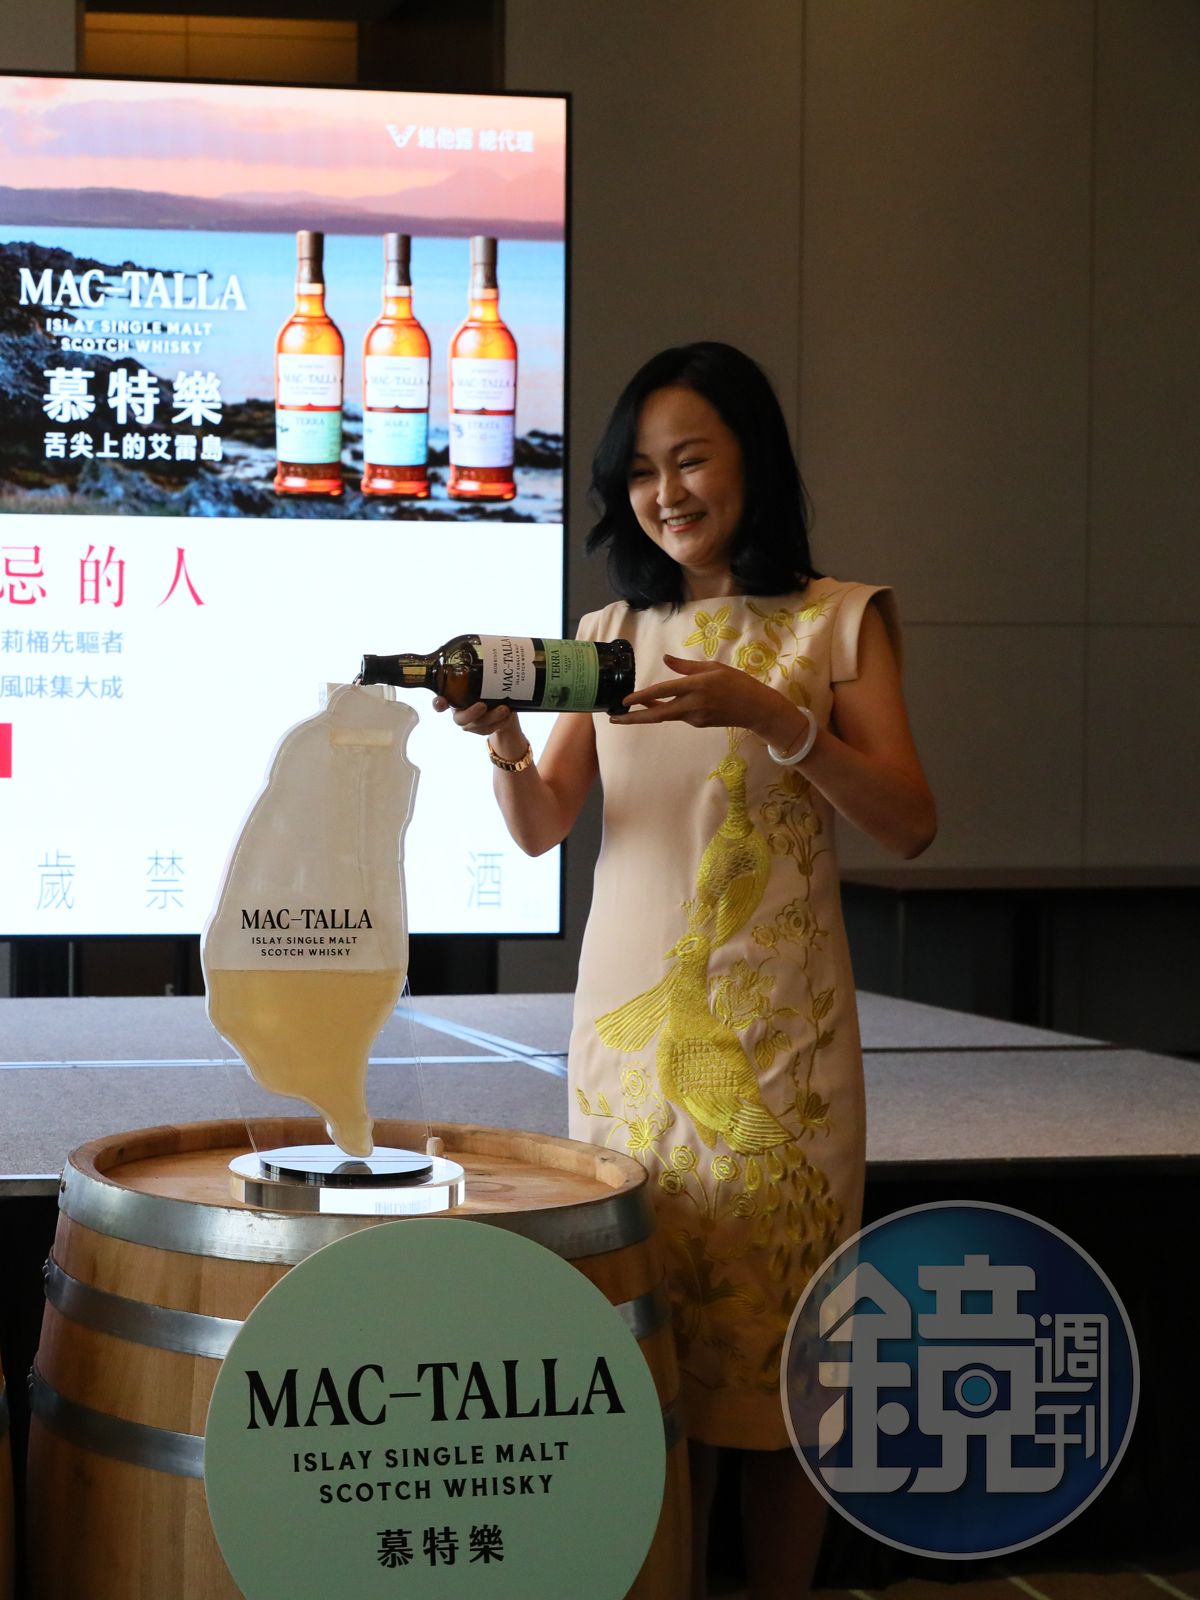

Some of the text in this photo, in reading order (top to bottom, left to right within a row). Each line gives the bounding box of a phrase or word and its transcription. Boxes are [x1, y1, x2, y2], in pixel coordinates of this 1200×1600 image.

[19, 268, 247, 311] MAC-TALLA
[46, 318, 212, 336] ISLAY SINGLE MALT
[61, 338, 203, 354] SCOTCH WHISKY
[42, 367, 223, 426] 慕特樂
[43, 432, 223, 461] 舌尖上的艾雷島
[501, 638, 513, 692] MAC-TALLA
[550, 650, 561, 680] TERRA
[467, 852, 504, 909] 酒
[241, 909, 372, 930] MAC-TALLA
[252, 937, 358, 945] ISLAY SINGLE MALT
[261, 948, 351, 957] SCOTCH WHISKY
[245, 1356, 626, 1430] MAC-TALLA
[293, 1441, 570, 1473] ISLAY SINGLE MALT
[319, 1474, 553, 1504] SCOTCH WHISKY
[377, 1524, 505, 1569] 慕特樂
